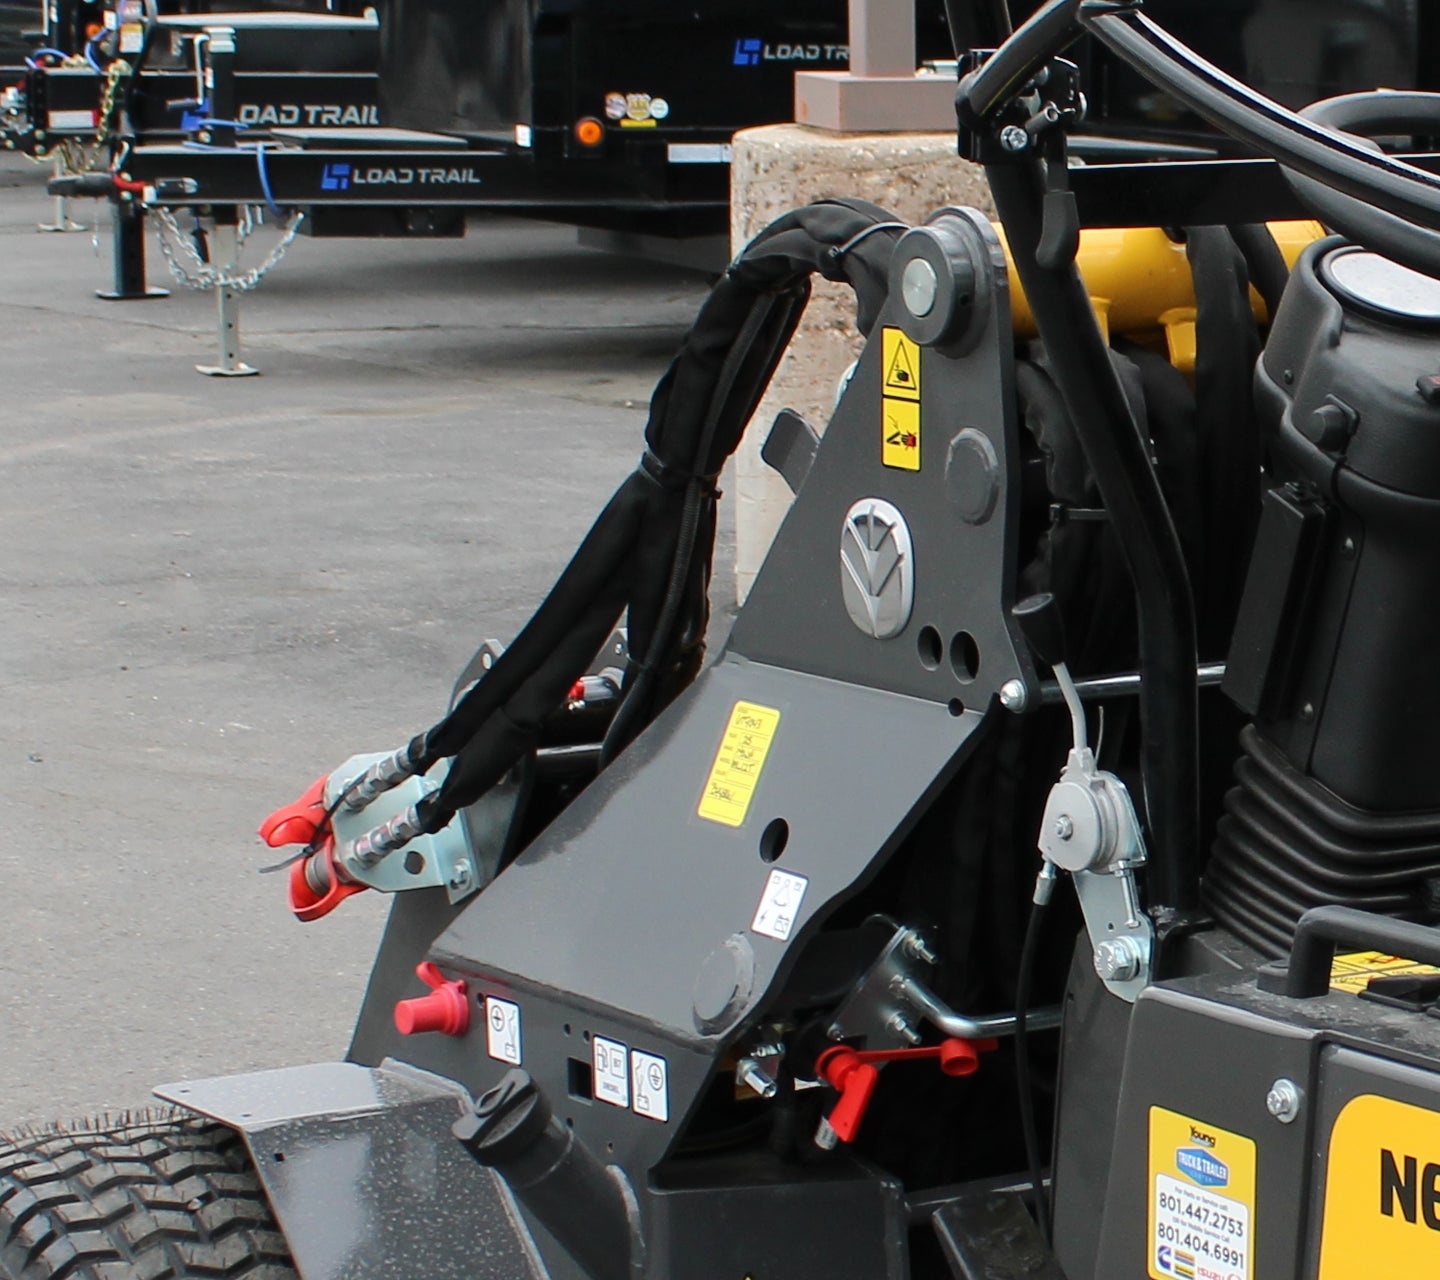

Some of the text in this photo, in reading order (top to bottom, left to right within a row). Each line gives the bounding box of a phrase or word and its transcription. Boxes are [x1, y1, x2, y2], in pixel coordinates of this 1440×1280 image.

[762, 44, 821, 61] LOAD
[352, 169, 482, 184] LOAD TRAIL
[1189, 1125, 1216, 1148] Young
[1159, 1191, 1244, 1238] 801.447.2753
[1158, 1222, 1244, 1269] 801.404.6991
